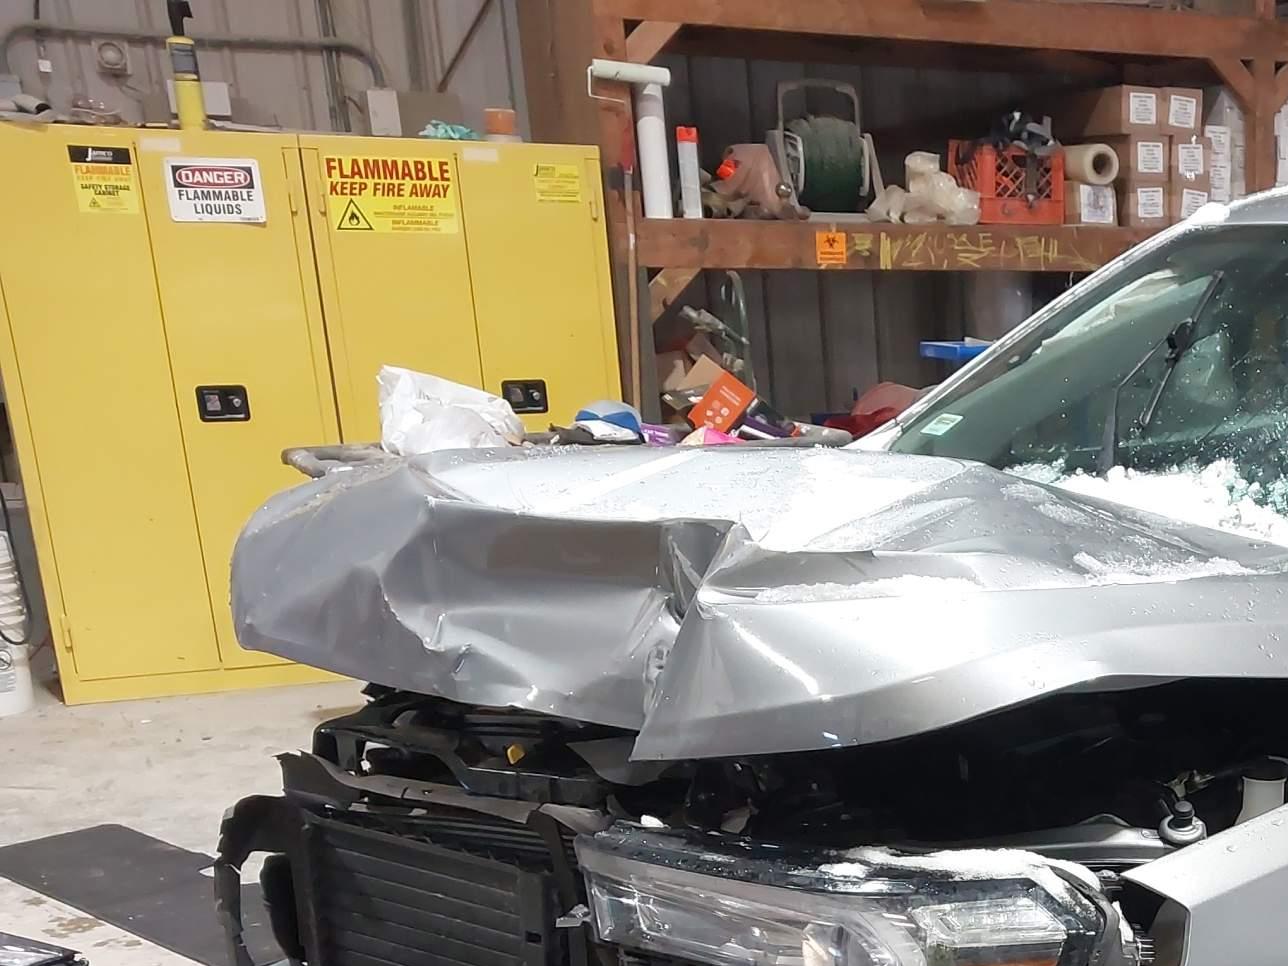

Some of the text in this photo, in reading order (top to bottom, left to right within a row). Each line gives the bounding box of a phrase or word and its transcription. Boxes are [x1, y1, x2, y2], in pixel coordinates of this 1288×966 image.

[181, 170, 246, 184] DANGER
[325, 158, 450, 182] FLAMMABLE
[177, 189, 254, 201] FLAMMABLE
[329, 181, 450, 198] KEEP FIRE AWAY
[193, 203, 242, 215] LIQUIDS
